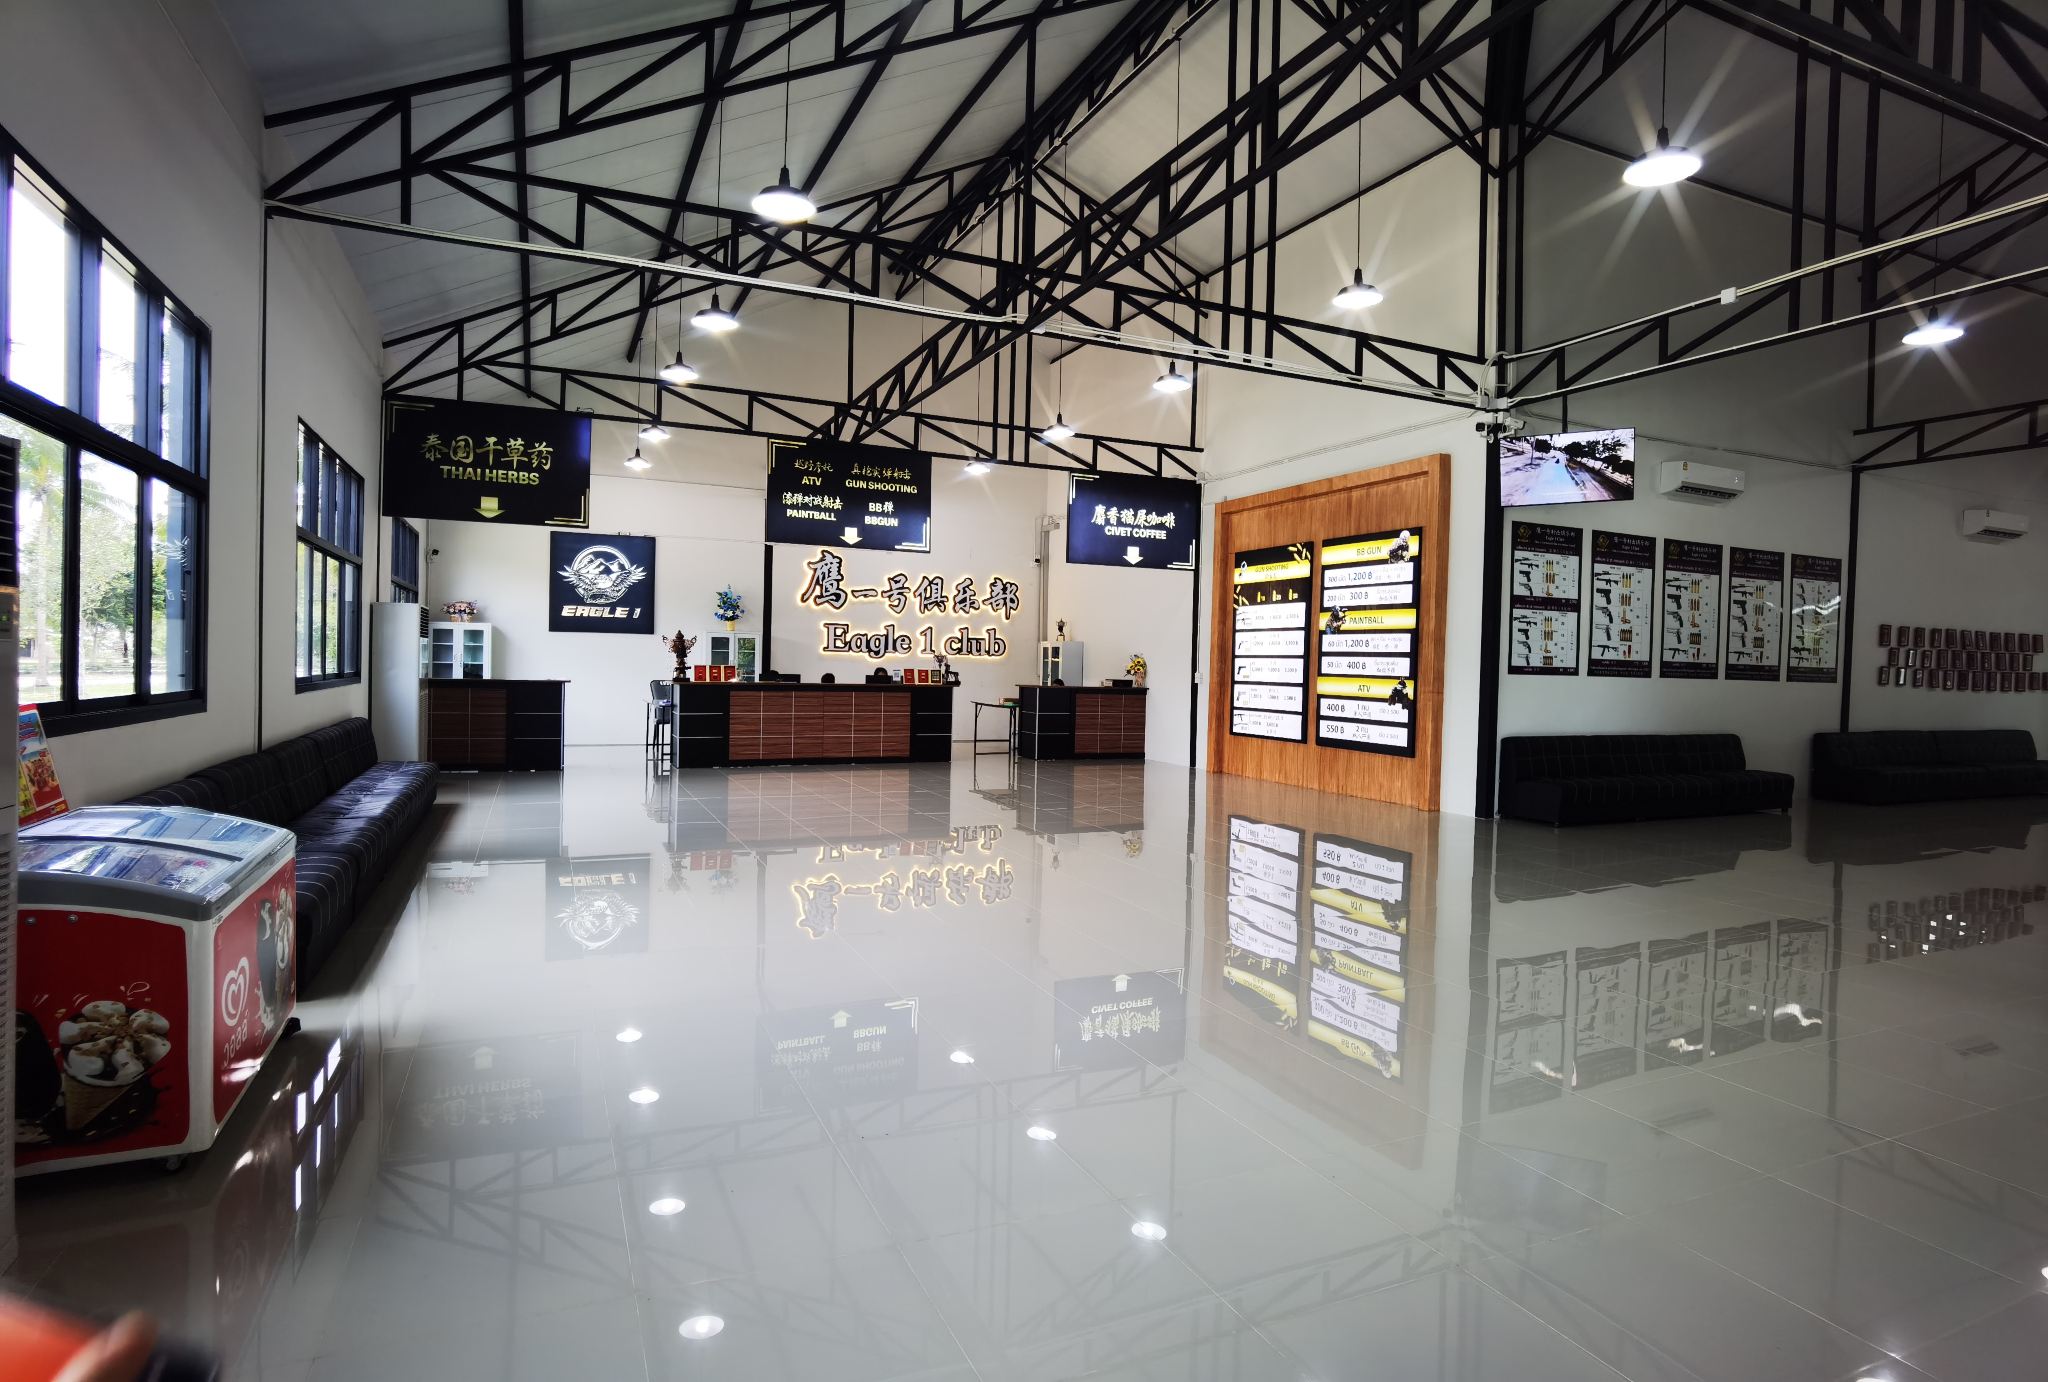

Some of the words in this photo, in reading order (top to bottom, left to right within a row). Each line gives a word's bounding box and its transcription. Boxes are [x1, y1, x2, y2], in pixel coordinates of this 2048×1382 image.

[440, 465, 481, 481] THAI
[485, 469, 540, 485] HERBS
[802, 476, 822, 486] ATV
[845, 479, 867, 489] GUN
[868, 481, 917, 493] SHOOTING
[787, 509, 836, 521] PAINTBALL
[865, 515, 898, 527] BBGUN
[1104, 525, 1132, 537] CIVET
[1132, 529, 1167, 539] COFFEE
[1366, 546, 1382, 554] GUN
[1348, 571, 1366, 583] 1,200
[800, 550, 1019, 620] 鹰一号俱乐部
[1349, 591, 1362, 601] 300
[561, 605, 630, 618] EAGLE
[1348, 616, 1384, 625] PAINTBALL
[823, 623, 912, 659] Eagle
[919, 626, 936, 655] 1
[944, 627, 1006, 656] club
[1344, 639, 1364, 648] 1,200
[1346, 661, 1361, 670] 400
[1357, 684, 1371, 693] ATV
[1326, 703, 1340, 712] 400
[1326, 724, 1339, 733] 550
